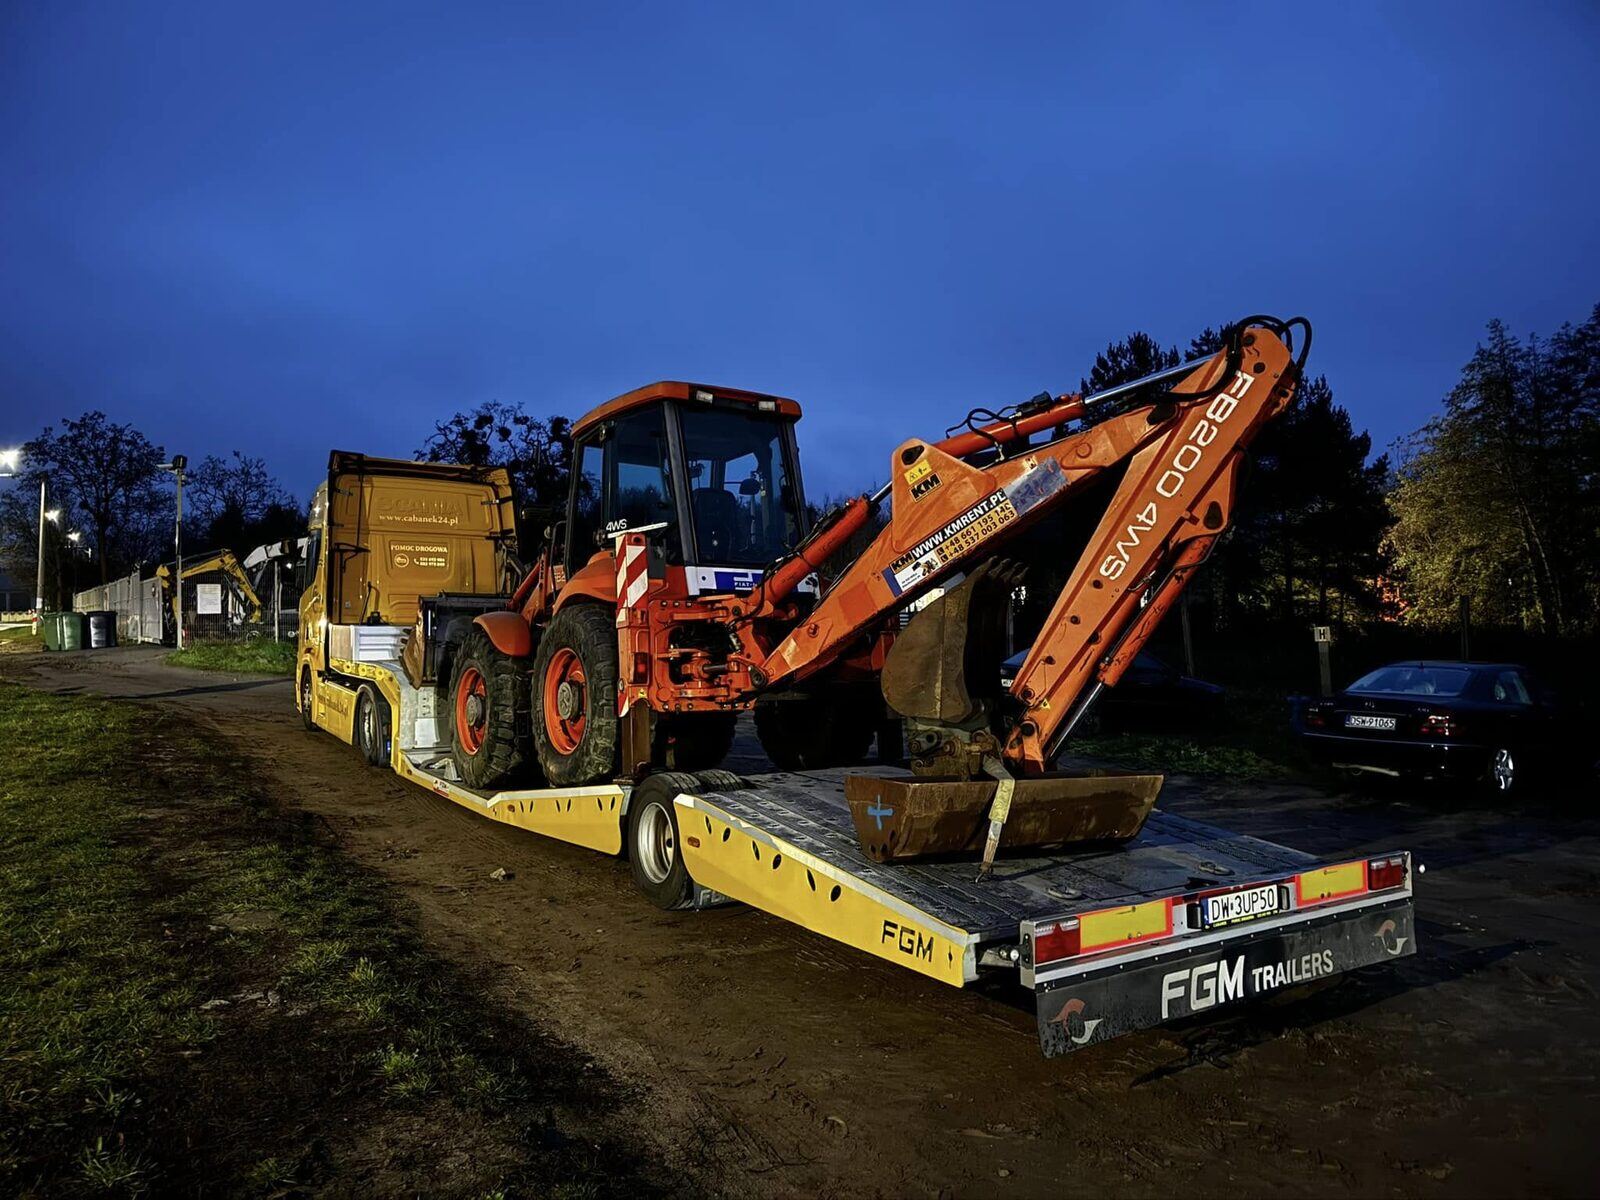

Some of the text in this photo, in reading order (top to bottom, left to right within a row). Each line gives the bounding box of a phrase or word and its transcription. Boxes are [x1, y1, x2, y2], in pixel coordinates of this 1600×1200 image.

[911, 475, 939, 500] KM
[1100, 371, 1254, 581] FB200 4WS
[379, 514, 459, 526] www.cabanek24.pl
[606, 519, 627, 532] 4WS
[912, 491, 1006, 558] WWW.KMRENT.PL
[944, 536, 960, 551] +48
[960, 525, 976, 540] 661
[977, 513, 994, 528] 195
[948, 509, 1015, 558] +48 537 003 063
[391, 544, 448, 553] POMOC DROGOWA
[891, 553, 912, 570] KM
[1212, 898, 1230, 921] DW
[1235, 888, 1275, 915] 3UP50
[881, 919, 935, 963] FGM
[1162, 949, 1333, 1019] FGM TRAILERS
